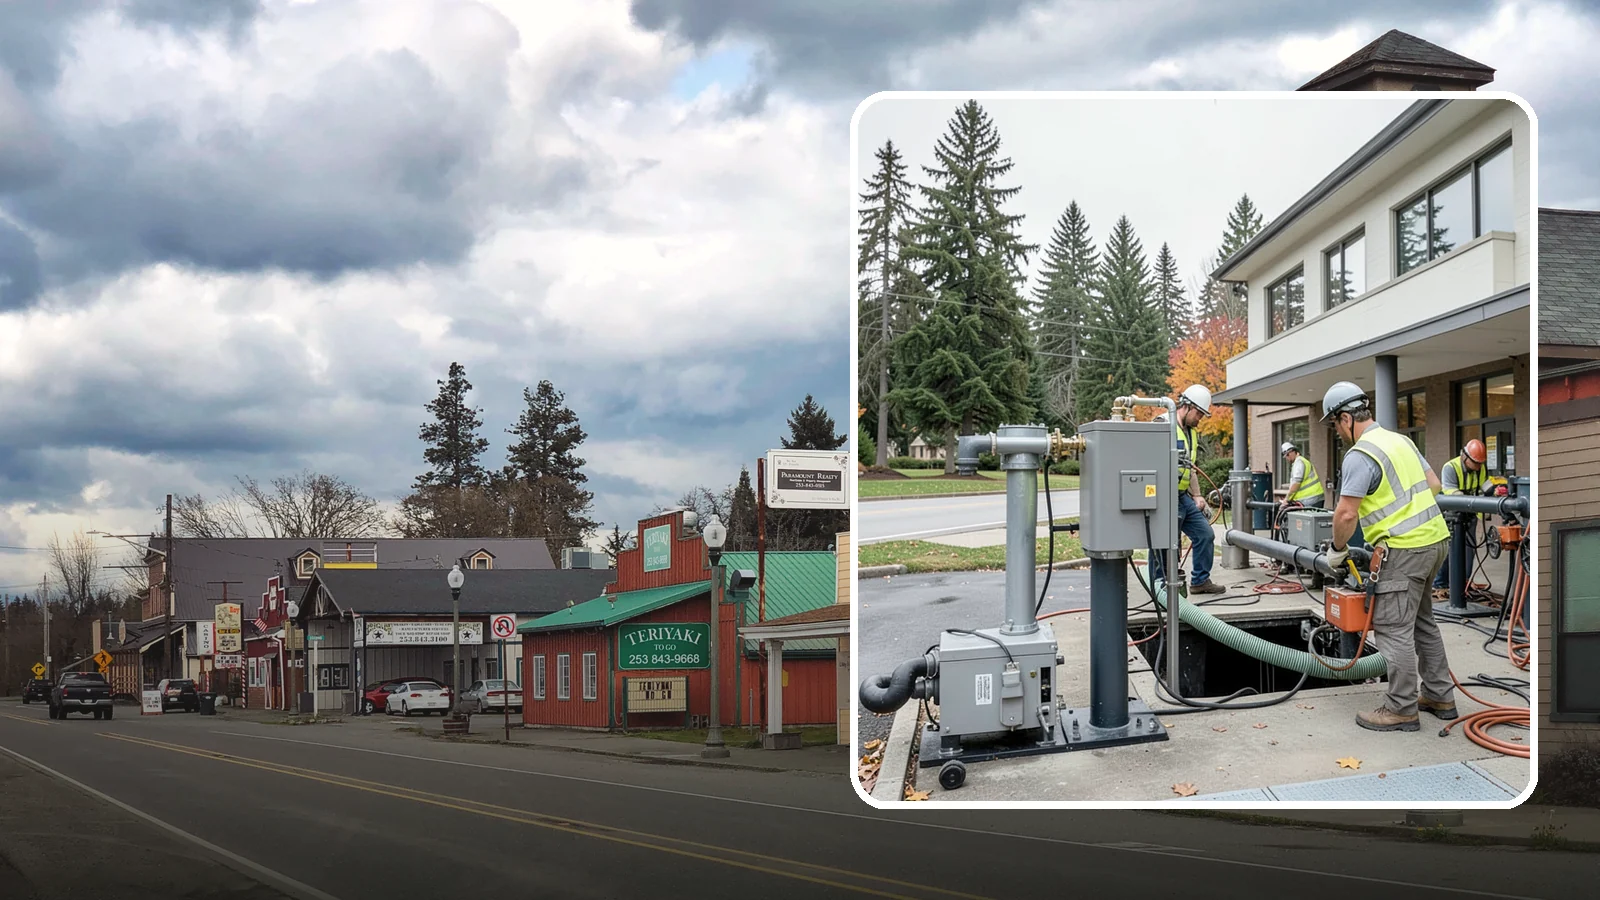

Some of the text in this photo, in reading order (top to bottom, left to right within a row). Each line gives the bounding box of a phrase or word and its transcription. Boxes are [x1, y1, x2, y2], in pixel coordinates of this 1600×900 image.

[624, 628, 702, 646] TERIYAKI
[629, 654, 700, 664] 253 843-9668
